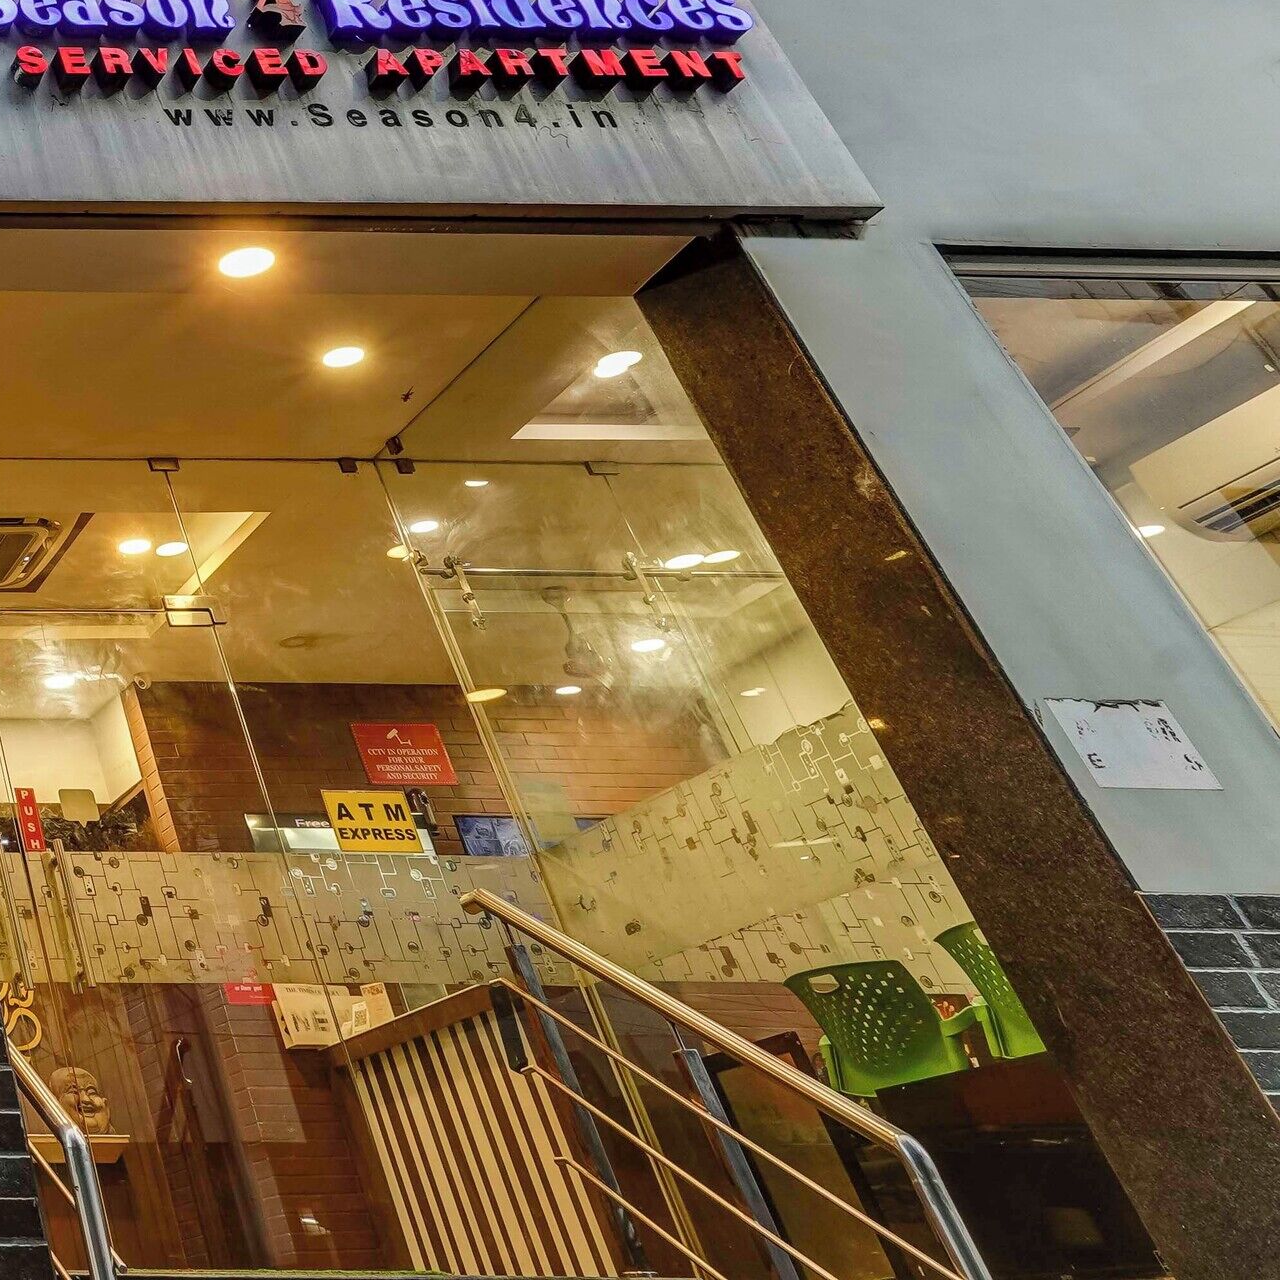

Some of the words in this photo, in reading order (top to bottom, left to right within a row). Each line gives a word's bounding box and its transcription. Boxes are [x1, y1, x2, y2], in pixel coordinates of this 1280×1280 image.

[15, 45, 329, 81] SERVICED
[372, 47, 746, 84] APARTMENT
[164, 103, 618, 129] www.Season4.in
[396, 748, 439, 756] OPERATION
[403, 756, 425, 764] YOUR
[376, 764, 415, 772] PERSONAL
[415, 764, 442, 772] SAFETY
[386, 772, 403, 780] AND
[403, 772, 438, 780] SECURITY
[337, 802, 407, 822] ATM
[20, 789, 41, 849] PUSH
[295, 818, 330, 828] Free
[339, 827, 417, 841] EXPRESS
